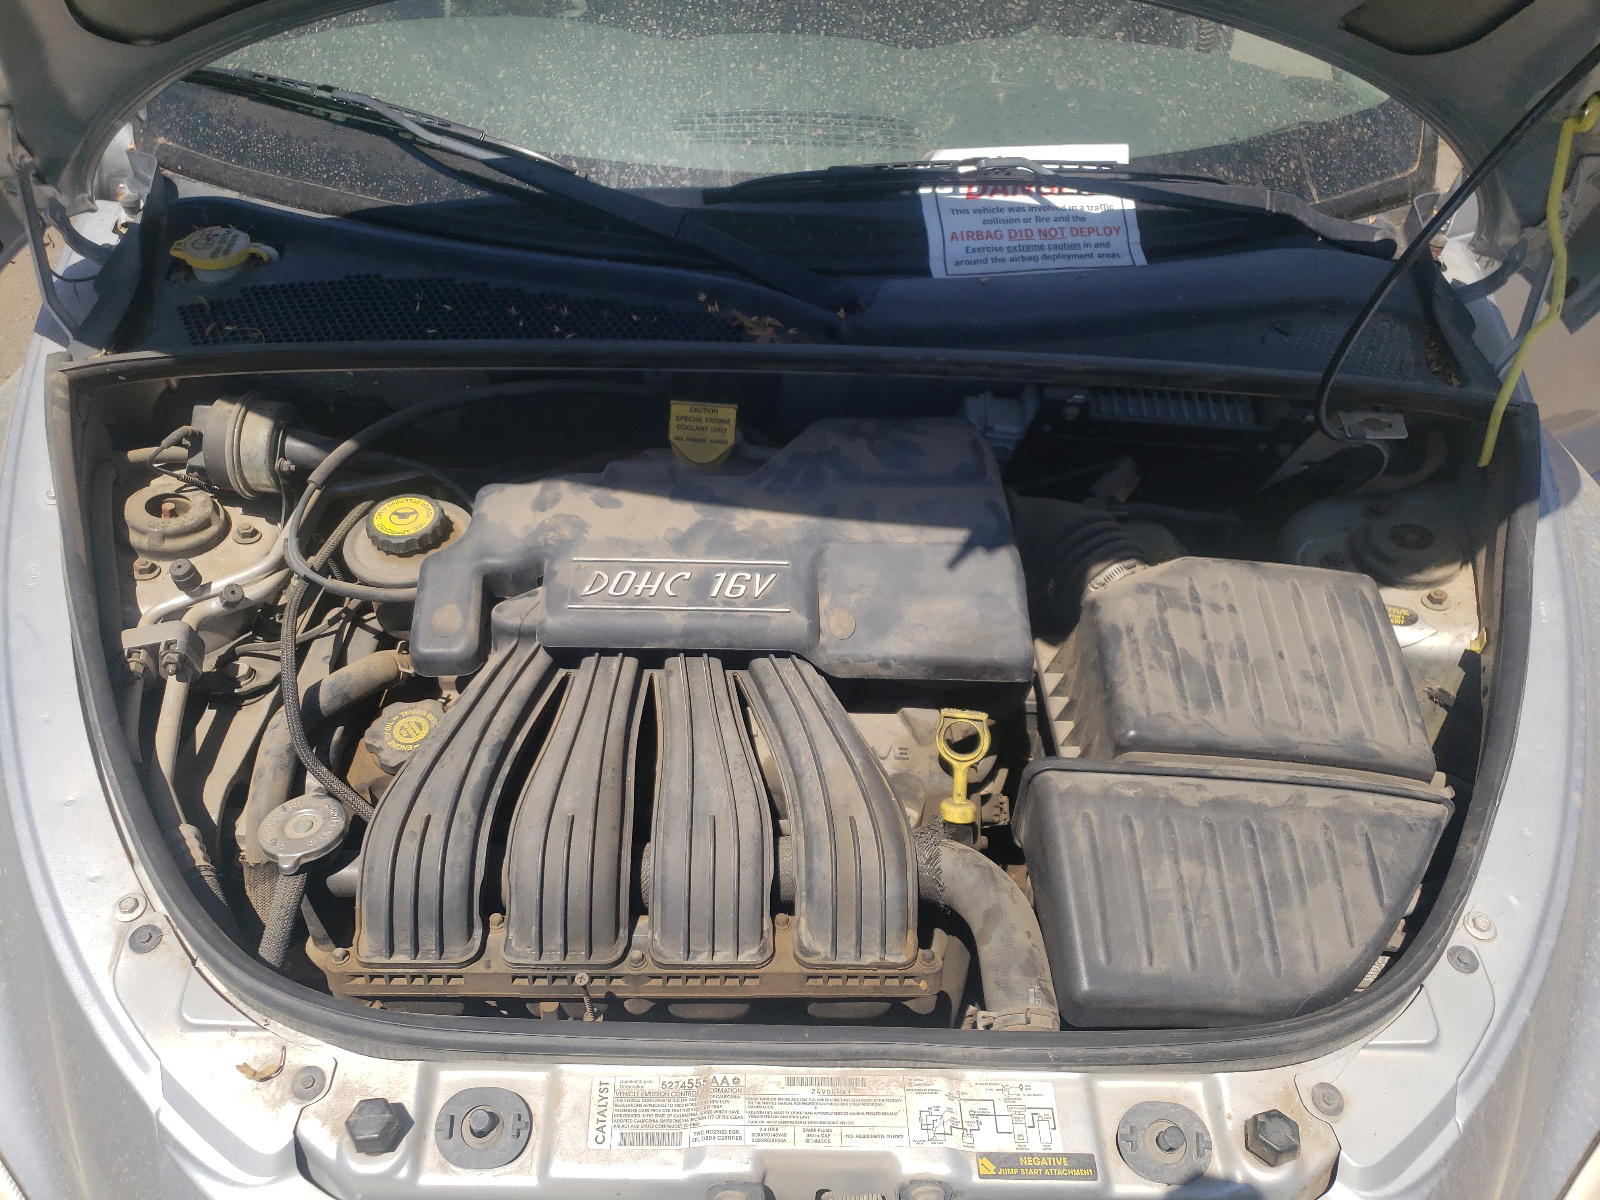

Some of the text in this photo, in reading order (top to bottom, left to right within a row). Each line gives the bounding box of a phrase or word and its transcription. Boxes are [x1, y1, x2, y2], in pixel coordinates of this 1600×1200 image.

[950, 207, 970, 215] This
[973, 206, 1004, 214] vehicle
[1086, 204, 1114, 212] traffic
[1035, 215, 1051, 223] fire
[1072, 214, 1087, 222] the
[950, 226, 1120, 241] AIRBAG DID NOT DEPLOY
[965, 245, 1004, 253] Exercise
[1007, 243, 1045, 252] extreme
[1047, 242, 1080, 250] caution
[955, 256, 988, 266] around
[991, 255, 1006, 264] the
[1009, 255, 1039, 263] airbag
[1041, 252, 1094, 262] deployment
[689, 406, 719, 414] CAUTION
[705, 417, 731, 425] ENGINE
[710, 425, 728, 433] ONLY
[580, 570, 778, 598] DOHC 16V
[594, 1080, 609, 1145] CATALYST
[1019, 1156, 1069, 1166] NEGATIVE
[1045, 1168, 1093, 1176] ATTACHMENT
